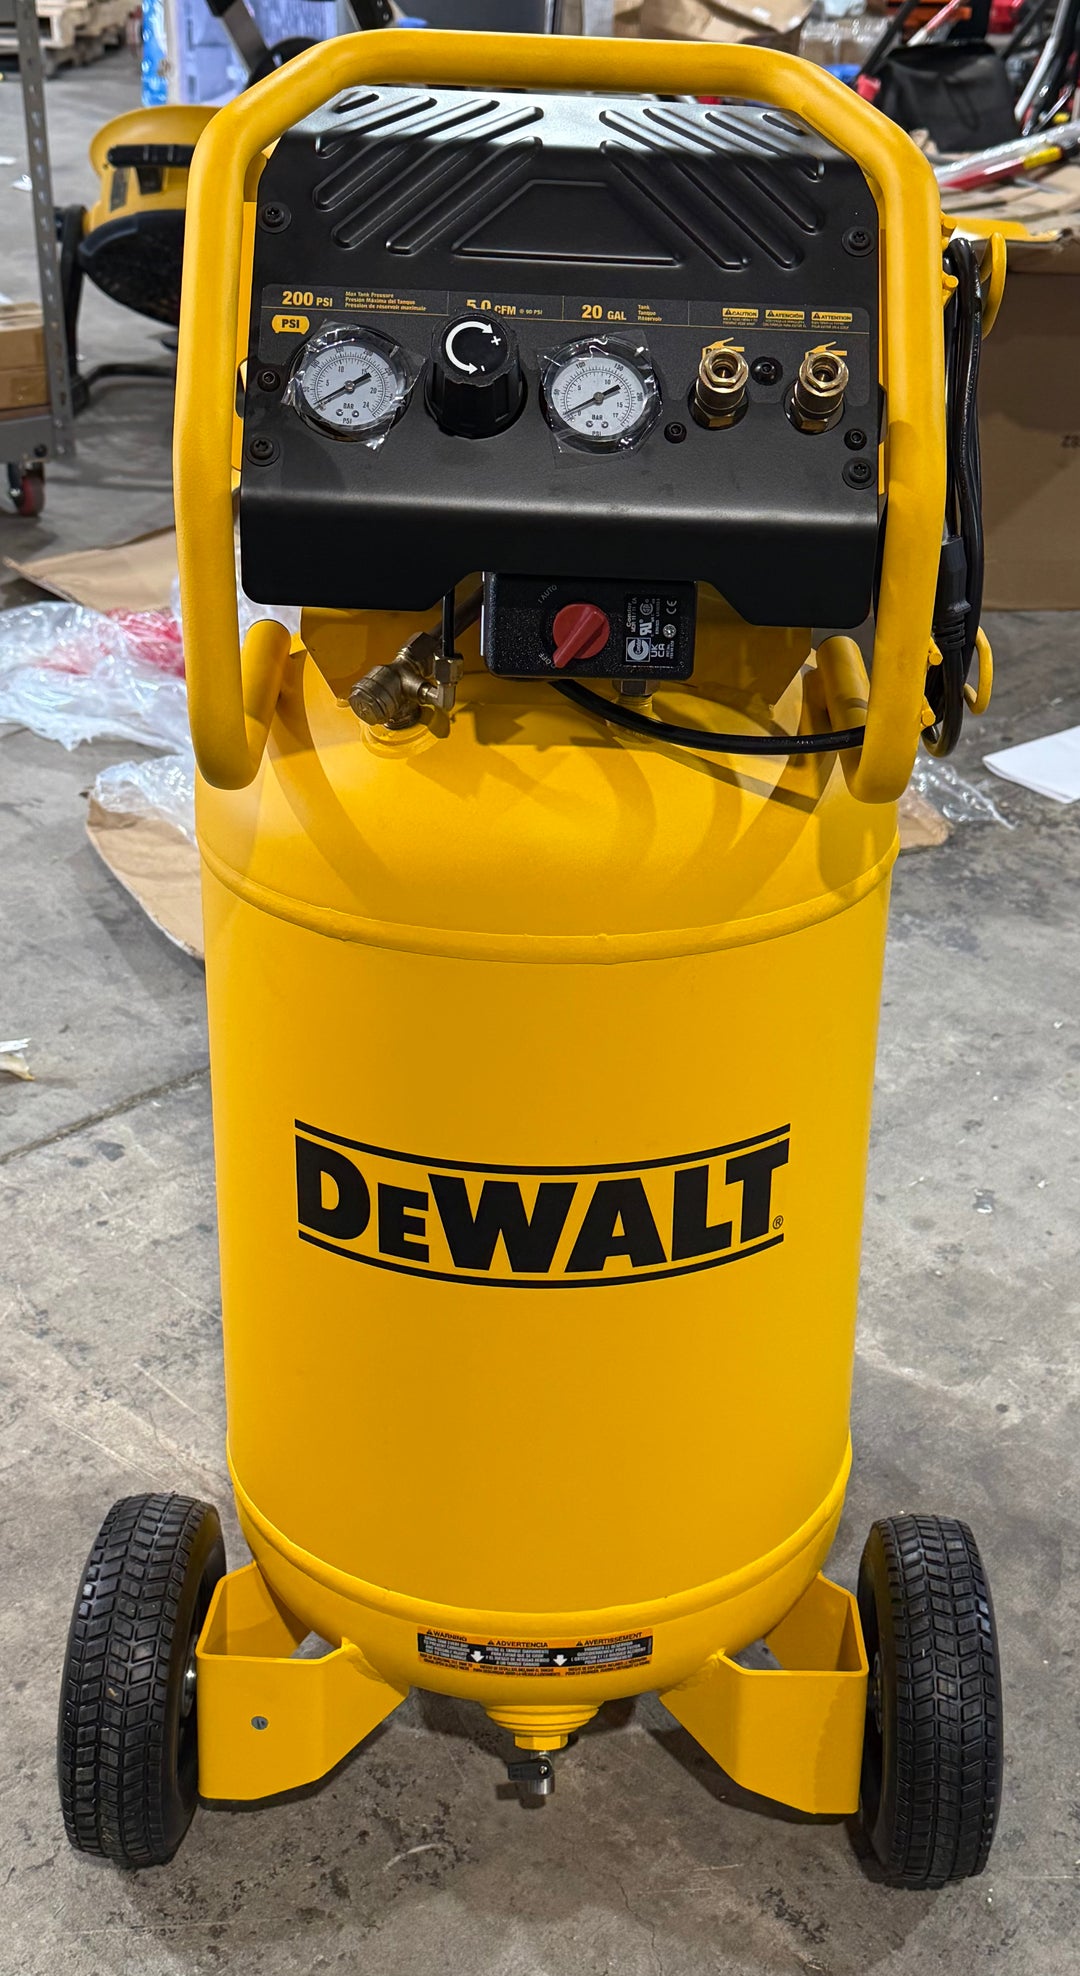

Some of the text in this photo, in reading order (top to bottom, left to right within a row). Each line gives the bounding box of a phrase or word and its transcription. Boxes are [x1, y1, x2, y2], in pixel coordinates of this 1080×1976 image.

[282, 290, 332, 307] 200 PSI
[494, 305, 516, 315] CFM
[582, 304, 627, 320] 20 GAL
[282, 319, 300, 328] PSI
[614, 363, 624, 372] 150
[541, 584, 558, 600] AUTO
[434, 1630, 468, 1642] WARNING
[584, 1632, 642, 1646] AVERTISSEMENT
